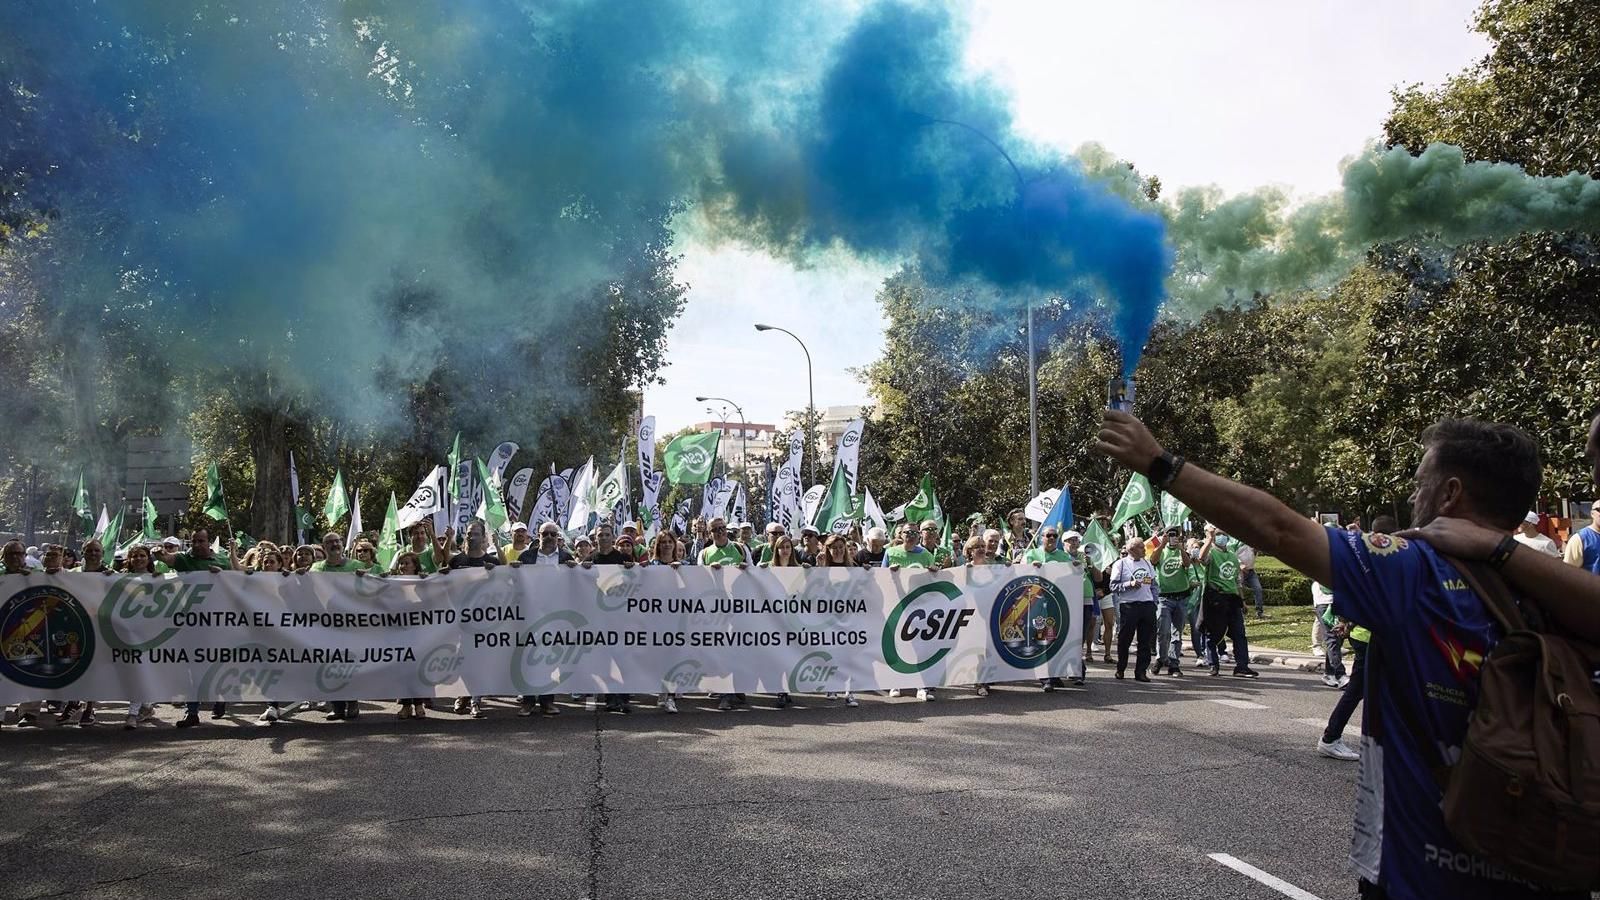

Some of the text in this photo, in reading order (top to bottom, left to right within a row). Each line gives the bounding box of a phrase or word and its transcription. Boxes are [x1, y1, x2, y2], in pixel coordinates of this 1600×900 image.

[119, 583, 214, 618] CSIF
[627, 595, 867, 614] POR UNA JUBILACIÓN DIGNA
[173, 606, 525, 628] CONTRA EL EMPOBRECIMIENTO SOCIAL
[900, 608, 975, 642] CSIF
[474, 627, 867, 648] POR LA CALIDAD DE LOS SERVICIOS PÚBLICOS
[112, 647, 416, 664] POR UNA SUBIDA SALARIAL JUSTA
[798, 665, 838, 683] CSIF
